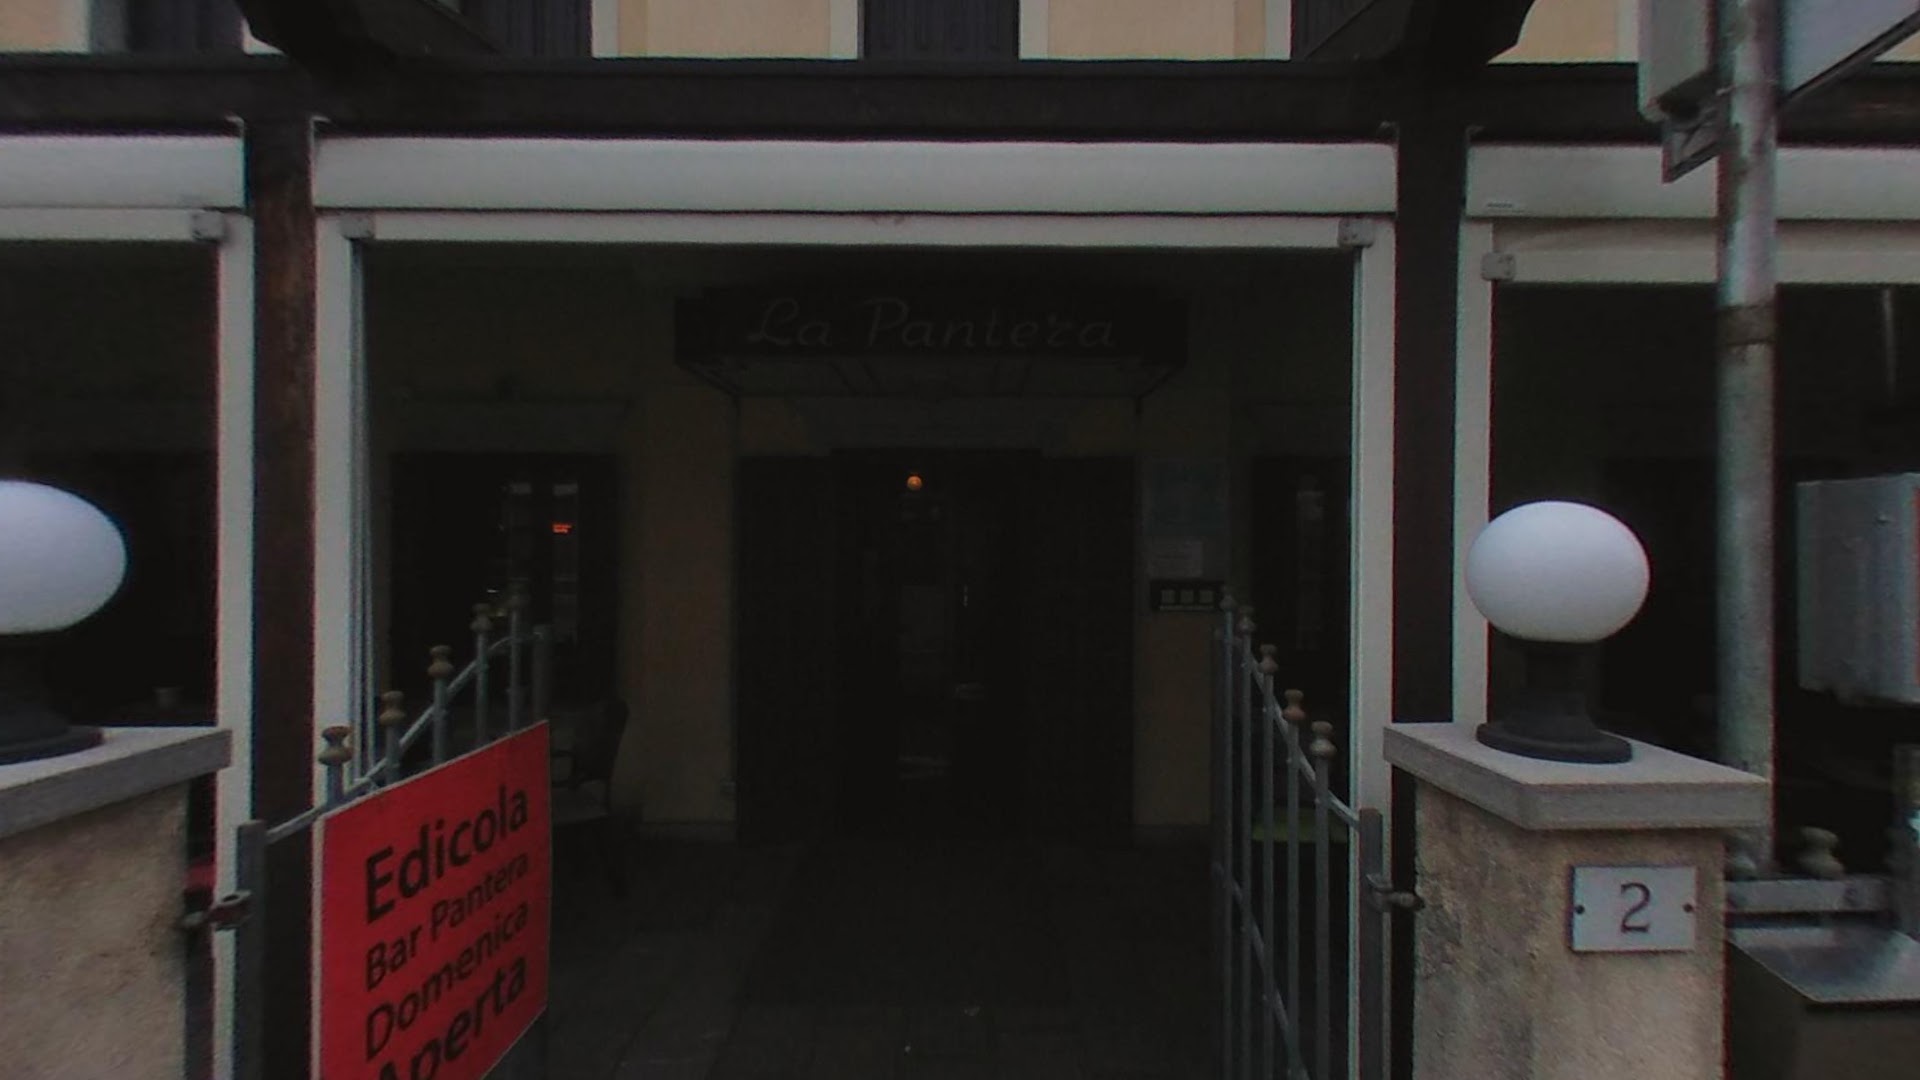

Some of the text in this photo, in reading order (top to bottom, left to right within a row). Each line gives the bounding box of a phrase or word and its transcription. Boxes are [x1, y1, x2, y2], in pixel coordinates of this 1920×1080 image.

[745, 298, 1116, 348] La Pantera
[365, 785, 529, 924] Edicola
[1620, 881, 1650, 933] 2
[365, 900, 529, 1063] Domenica
[366, 853, 529, 992] Bar Pantera
[376, 956, 528, 1080] perta
